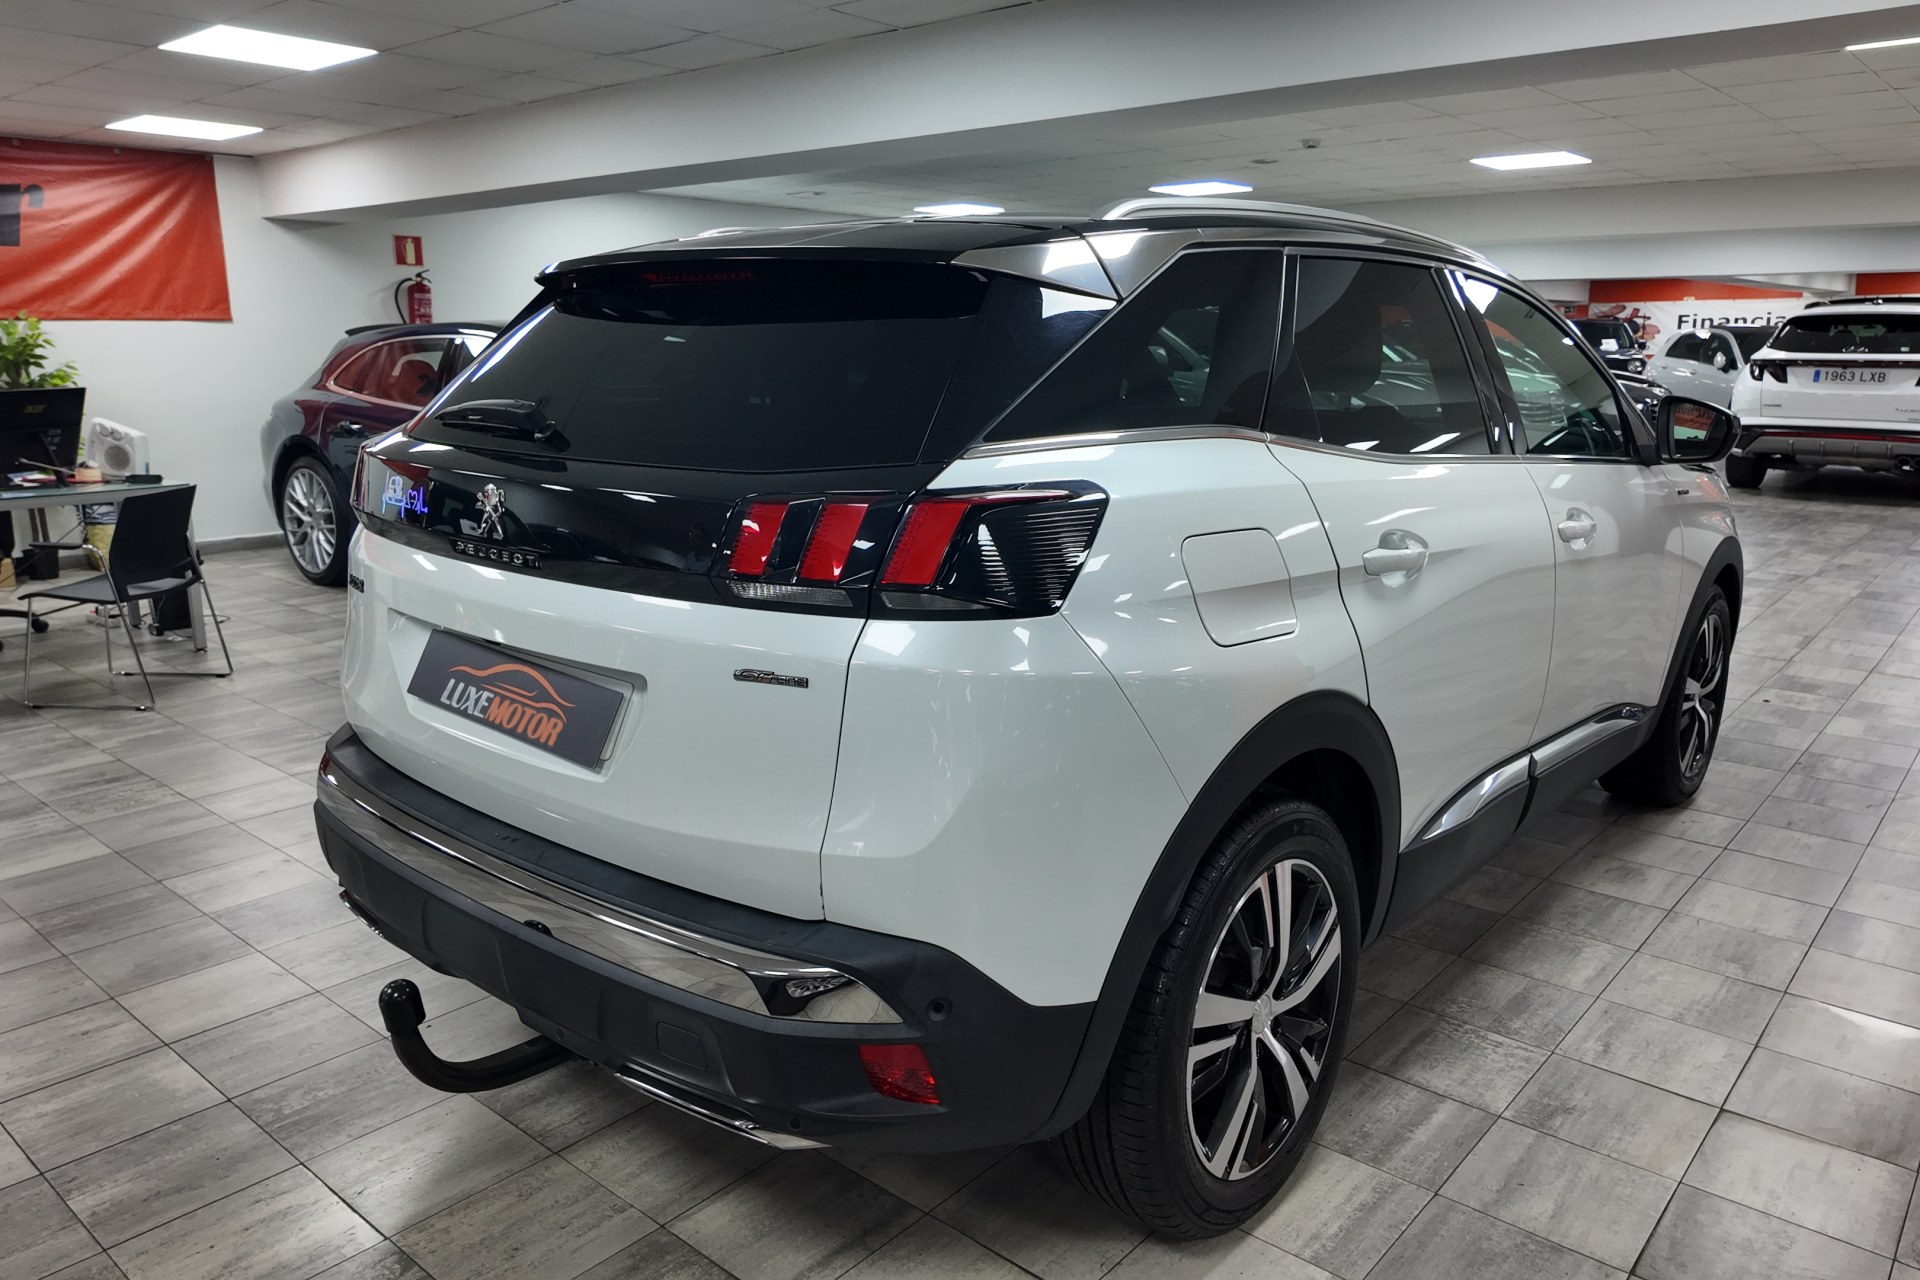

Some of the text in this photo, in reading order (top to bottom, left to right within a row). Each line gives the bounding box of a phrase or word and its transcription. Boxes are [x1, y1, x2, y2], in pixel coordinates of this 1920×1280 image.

[1824, 371, 1887, 383] 1963 LXB
[440, 678, 564, 747] LUXEMOTOR
